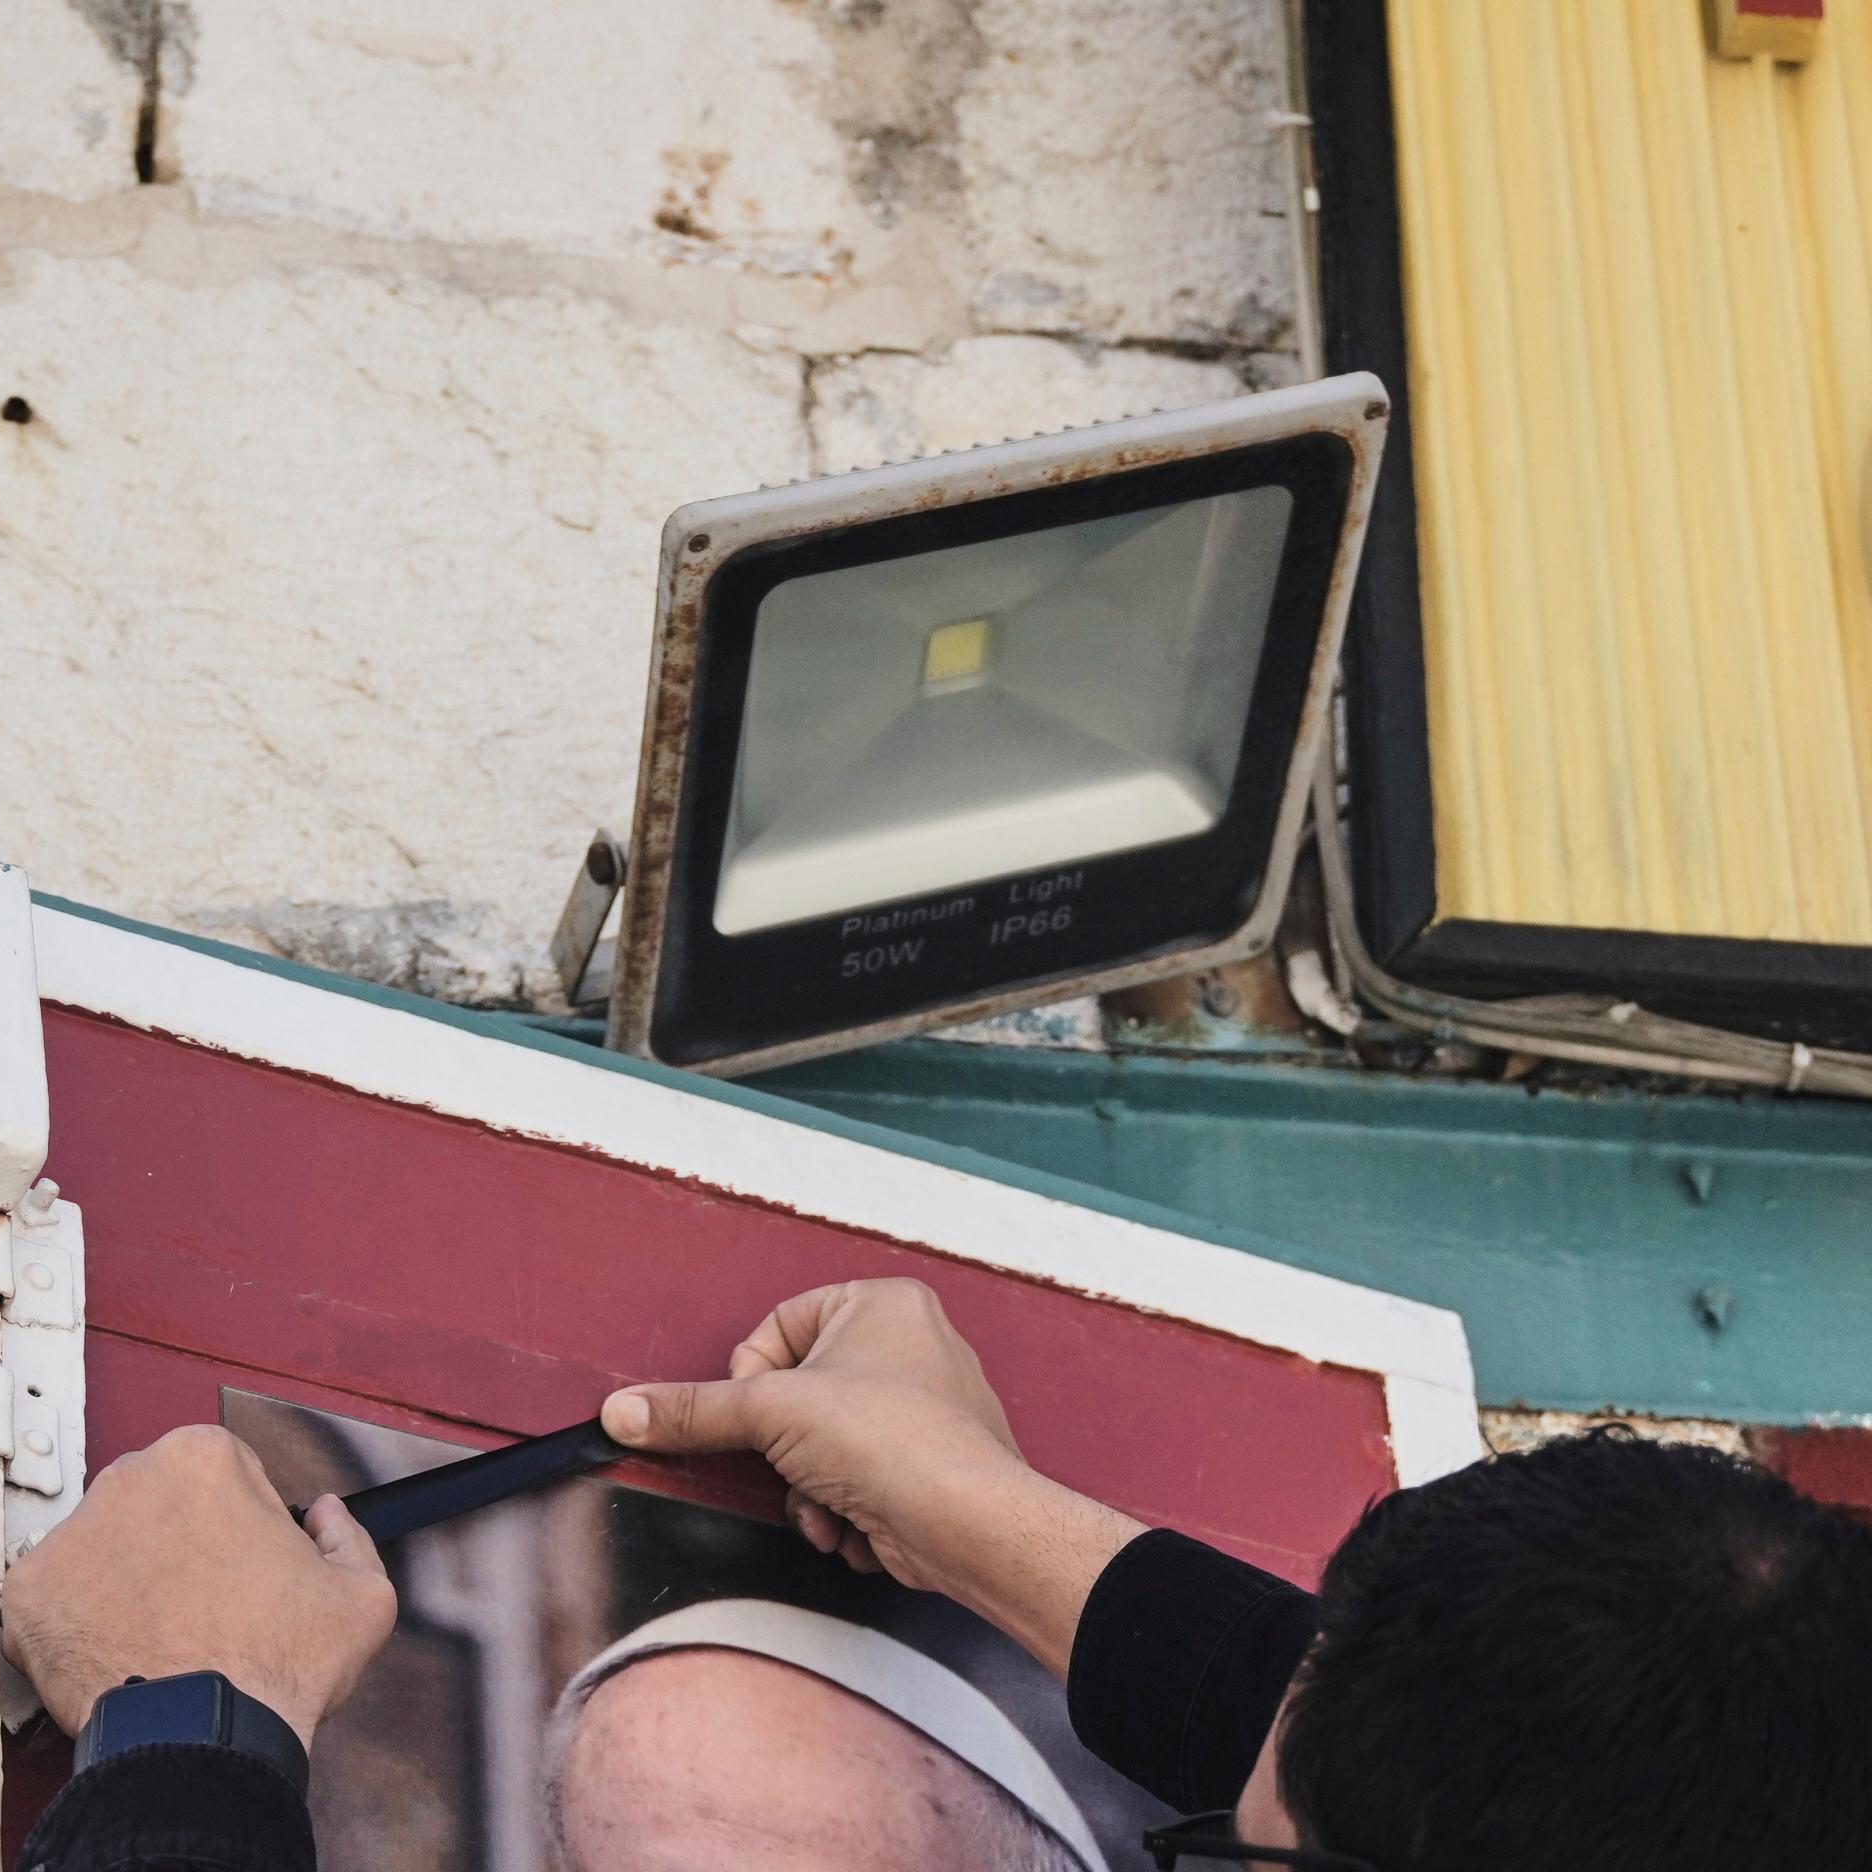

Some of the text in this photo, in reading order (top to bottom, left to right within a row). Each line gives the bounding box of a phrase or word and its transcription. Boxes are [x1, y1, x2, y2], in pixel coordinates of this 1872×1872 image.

[841, 870, 1085, 940] Platinum Light
[841, 904, 1073, 978] 50W IP66
